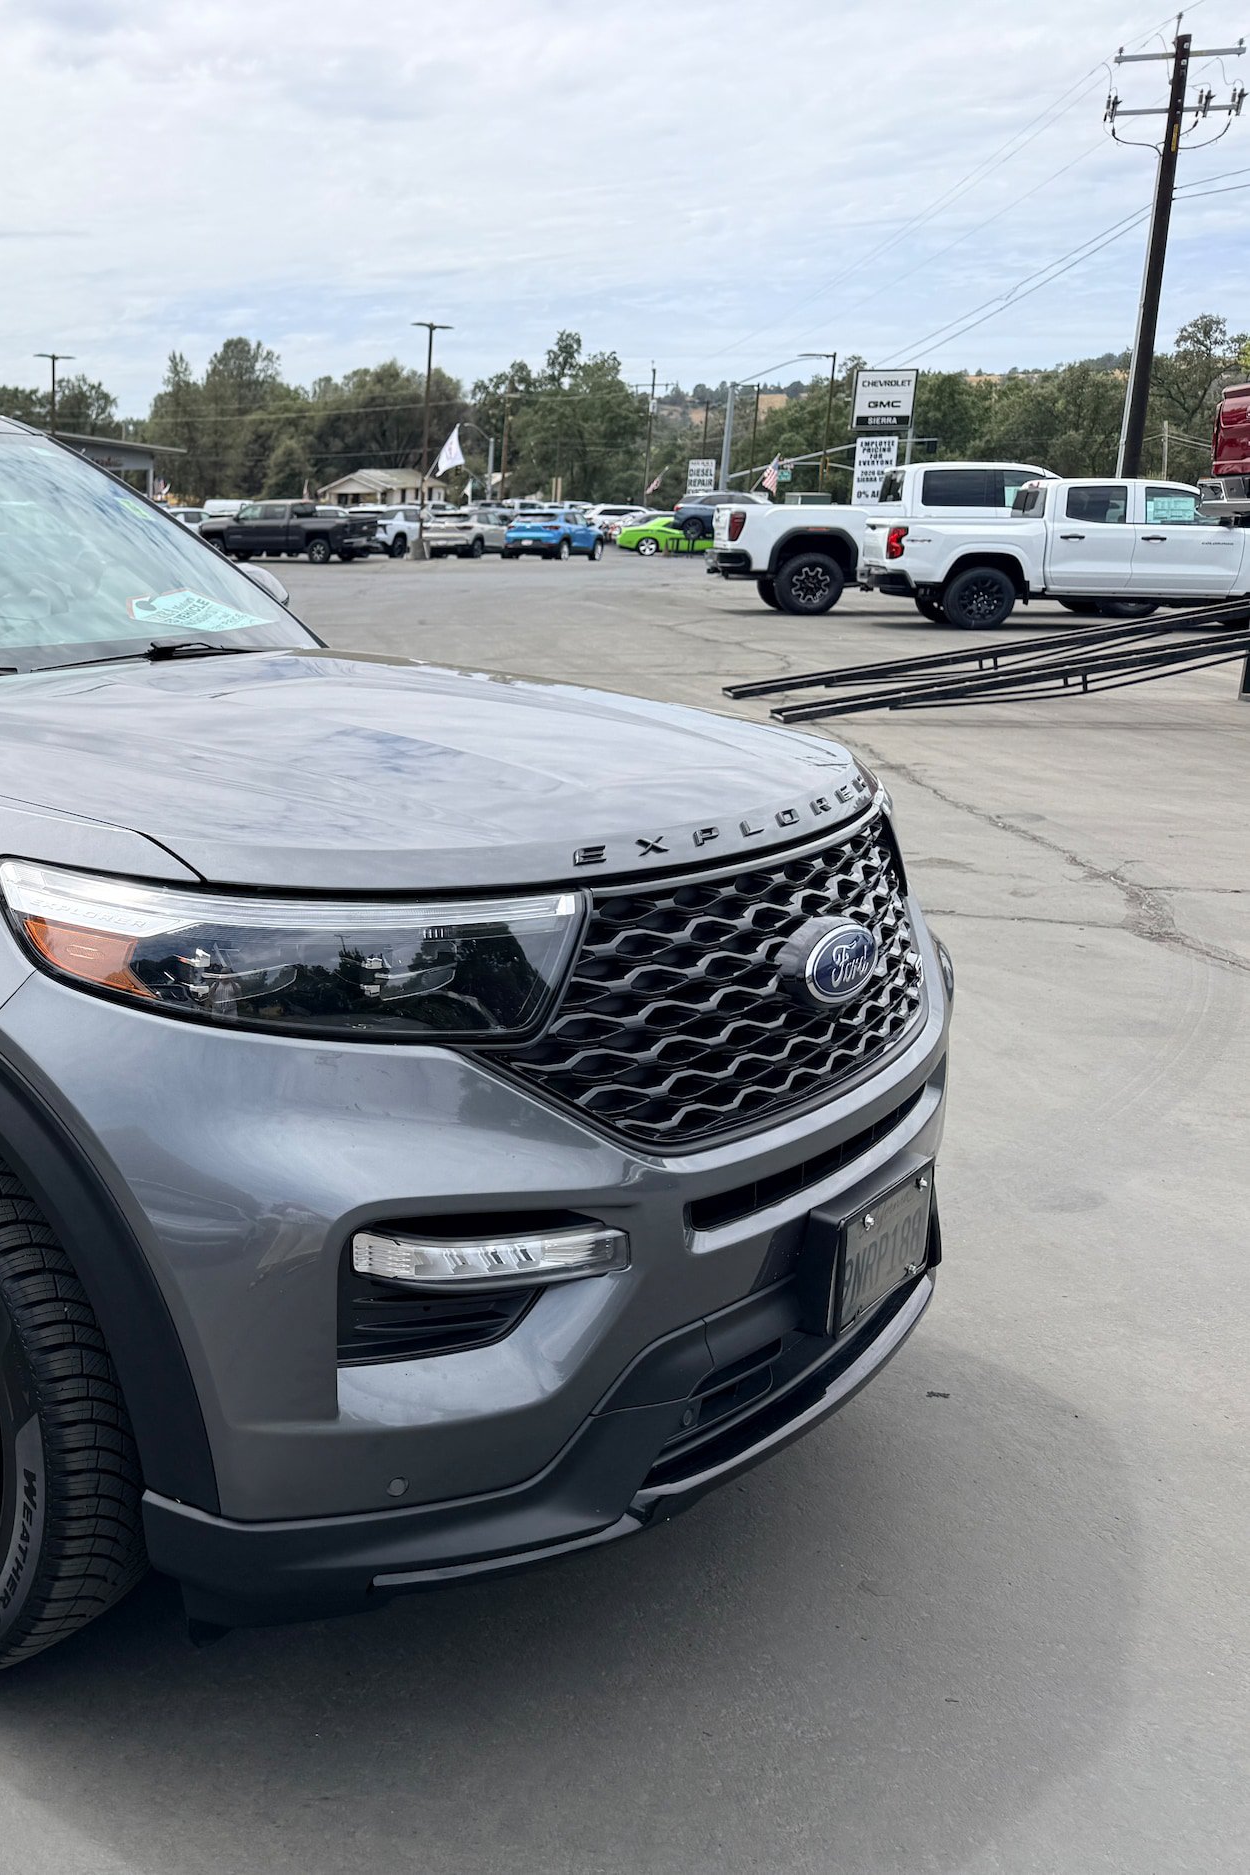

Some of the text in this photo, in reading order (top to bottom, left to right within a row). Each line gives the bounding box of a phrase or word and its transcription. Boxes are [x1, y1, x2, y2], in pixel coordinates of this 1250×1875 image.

[862, 379, 912, 388] CHEVROLET
[868, 400, 901, 408] GMC
[867, 416, 897, 425] SIERRA
[689, 468, 713, 477] DIESEL
[688, 478, 713, 487] REPAIR
[856, 490, 870, 499] 0%
[573, 774, 870, 867] EXPLORER
[29, 898, 147, 929] EXPLORER
[831, 936, 872, 989] Ford
